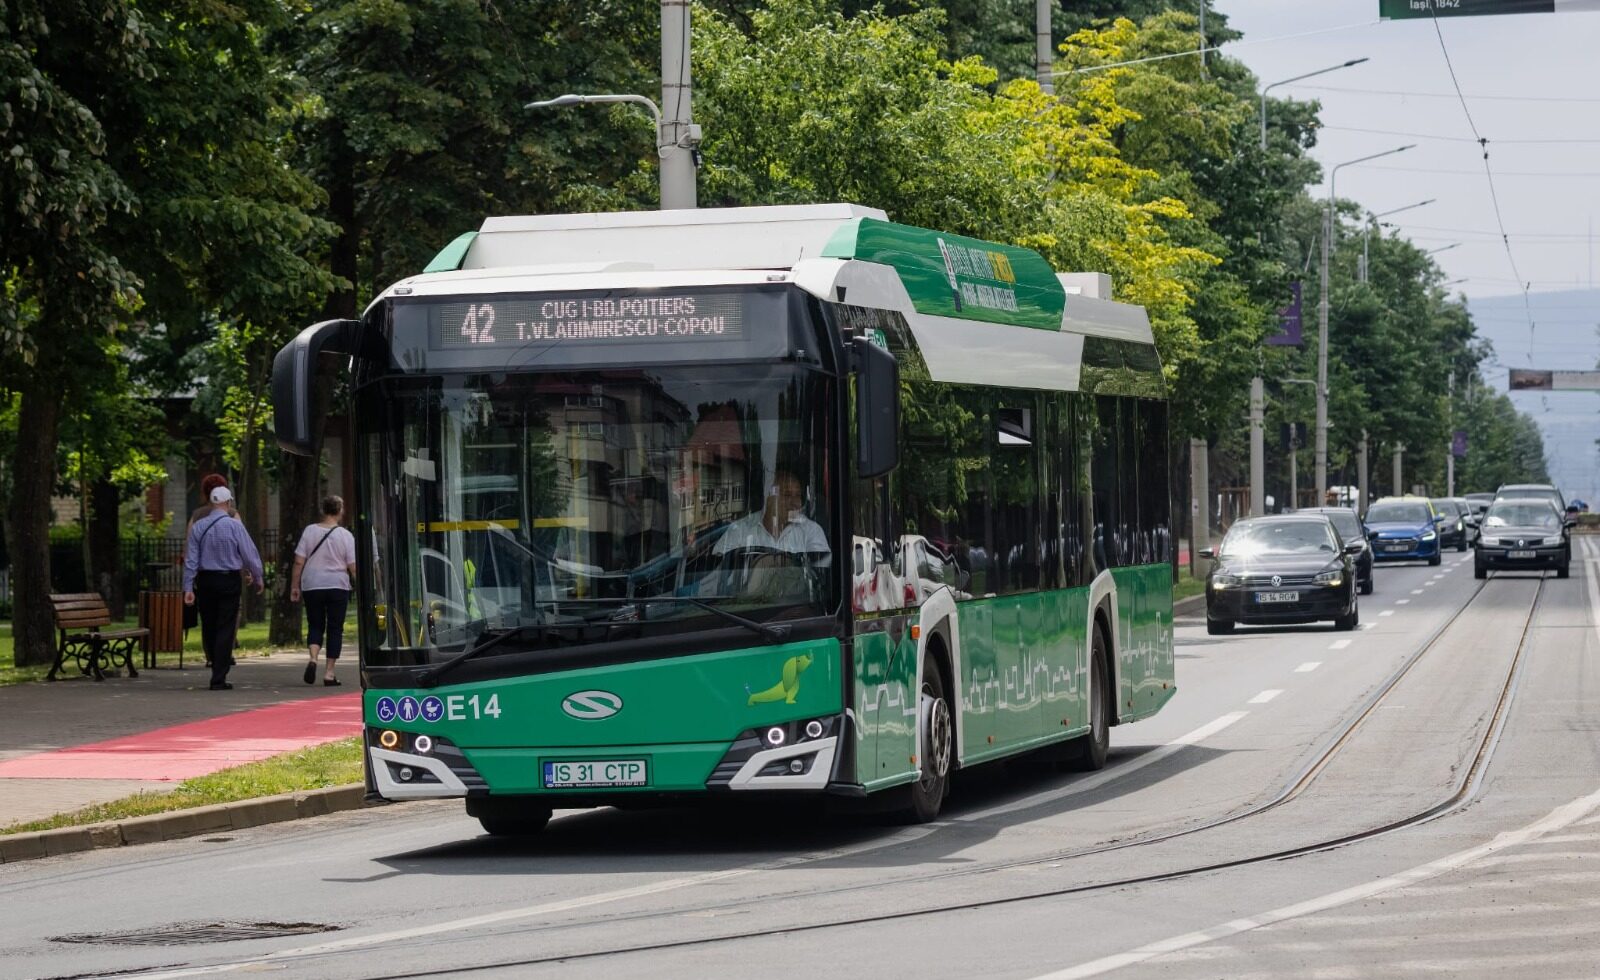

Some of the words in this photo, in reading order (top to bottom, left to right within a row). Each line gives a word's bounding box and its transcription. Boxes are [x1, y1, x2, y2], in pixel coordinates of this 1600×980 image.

[1436, 0, 1460, 8] 1842
[541, 302, 578, 319] CUG
[461, 304, 496, 343] 42
[447, 693, 502, 721] E14
[555, 764, 571, 782] IS
[578, 764, 593, 781] 31
[605, 763, 640, 780] CTP
